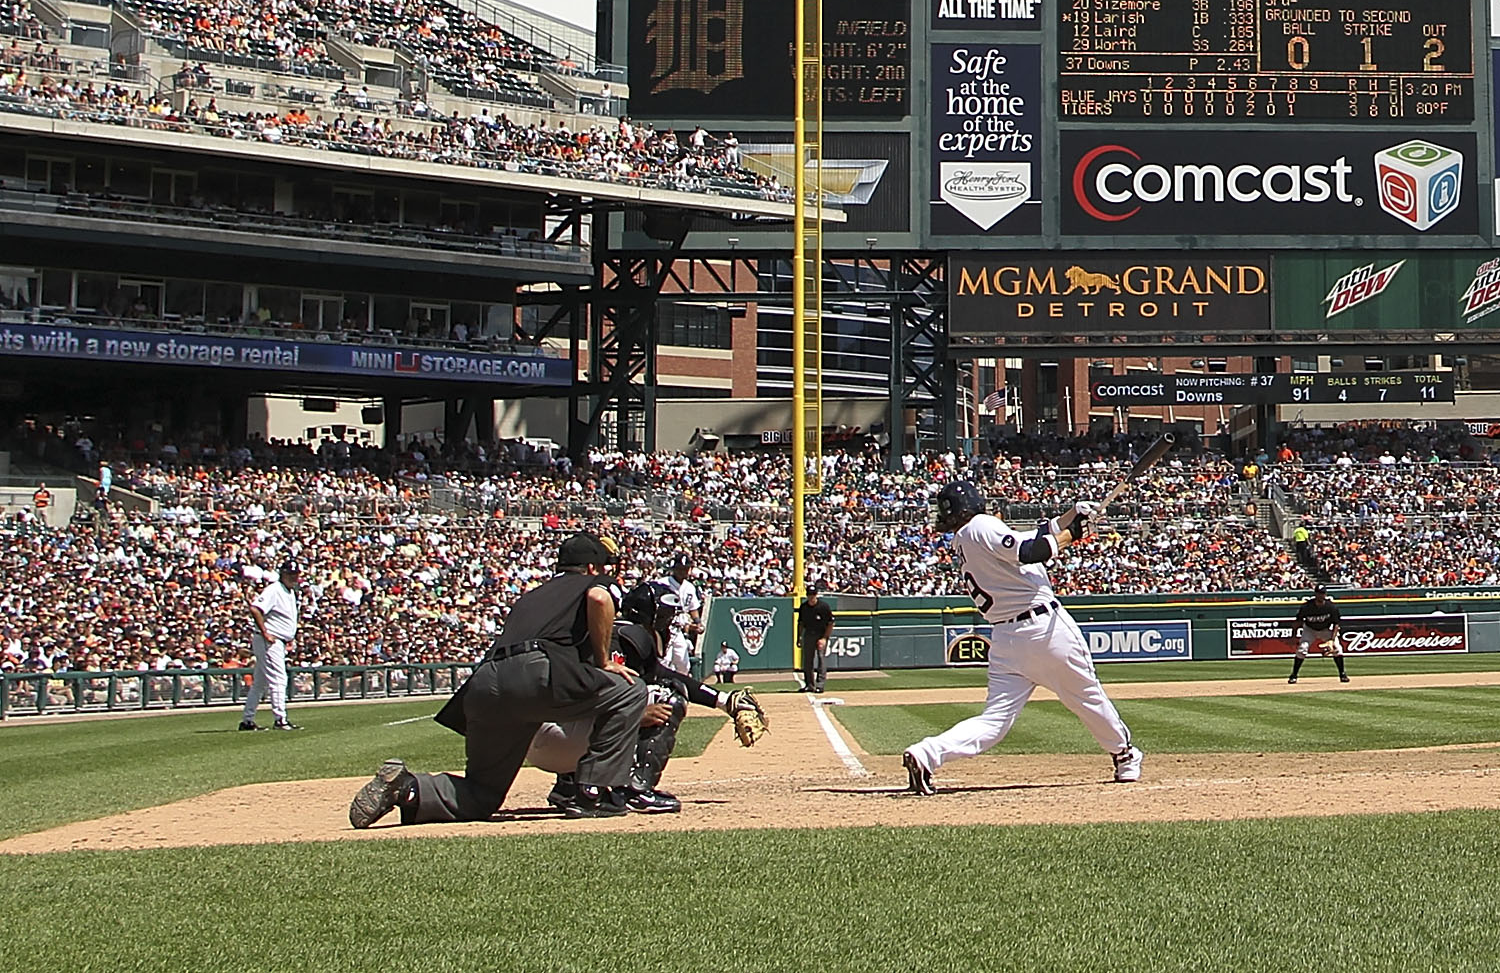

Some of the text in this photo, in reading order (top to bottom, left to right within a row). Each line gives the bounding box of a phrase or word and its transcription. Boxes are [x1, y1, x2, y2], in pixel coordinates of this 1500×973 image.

[938, 0, 966, 18] ALL
[968, 0, 995, 18] THE
[1266, 10, 1410, 22] GROUNDED TO SECOND
[1072, 12, 1144, 23] 19 Larish
[1072, 25, 1136, 37] 12 Laird
[1284, 23, 1446, 36] BALL STRIKE OUT
[1072, 39, 1136, 50] 29 Worth
[1287, 36, 1445, 71] 0 1 2
[950, 49, 1006, 80] Safe
[1066, 58, 1250, 70] 37 Downs 2.43
[859, 87, 906, 102] LEFT
[960, 79, 1010, 95] at the
[1405, 84, 1462, 96] 3:20 PM
[946, 88, 1024, 116] home
[1062, 90, 1136, 103] BLUE JAYS
[1062, 103, 1112, 115] TIGERS
[963, 116, 1014, 132] of the
[939, 130, 1032, 158] experts
[953, 170, 1021, 186] Henry Ford
[1096, 157, 1352, 202] comcast
[956, 266, 1266, 296] MGM GRAND
[1017, 302, 1209, 317] DETROIT
[31, 331, 299, 365] with a new storage rental
[1097, 383, 1164, 396] comcast
[1176, 378, 1198, 386] NOW
[1200, 378, 1245, 386] PITCHING:
[1261, 376, 1274, 385] 37
[1290, 375, 1442, 386] MPH BALLS STRIKES TOTAL
[1176, 390, 1223, 402] Downs
[1293, 386, 1435, 401] 91 4 7 11
[762, 430, 780, 443] BIG
[1091, 629, 1184, 653] DMC.org
[1343, 632, 1463, 651] Budweiser
[959, 640, 984, 658] ER
